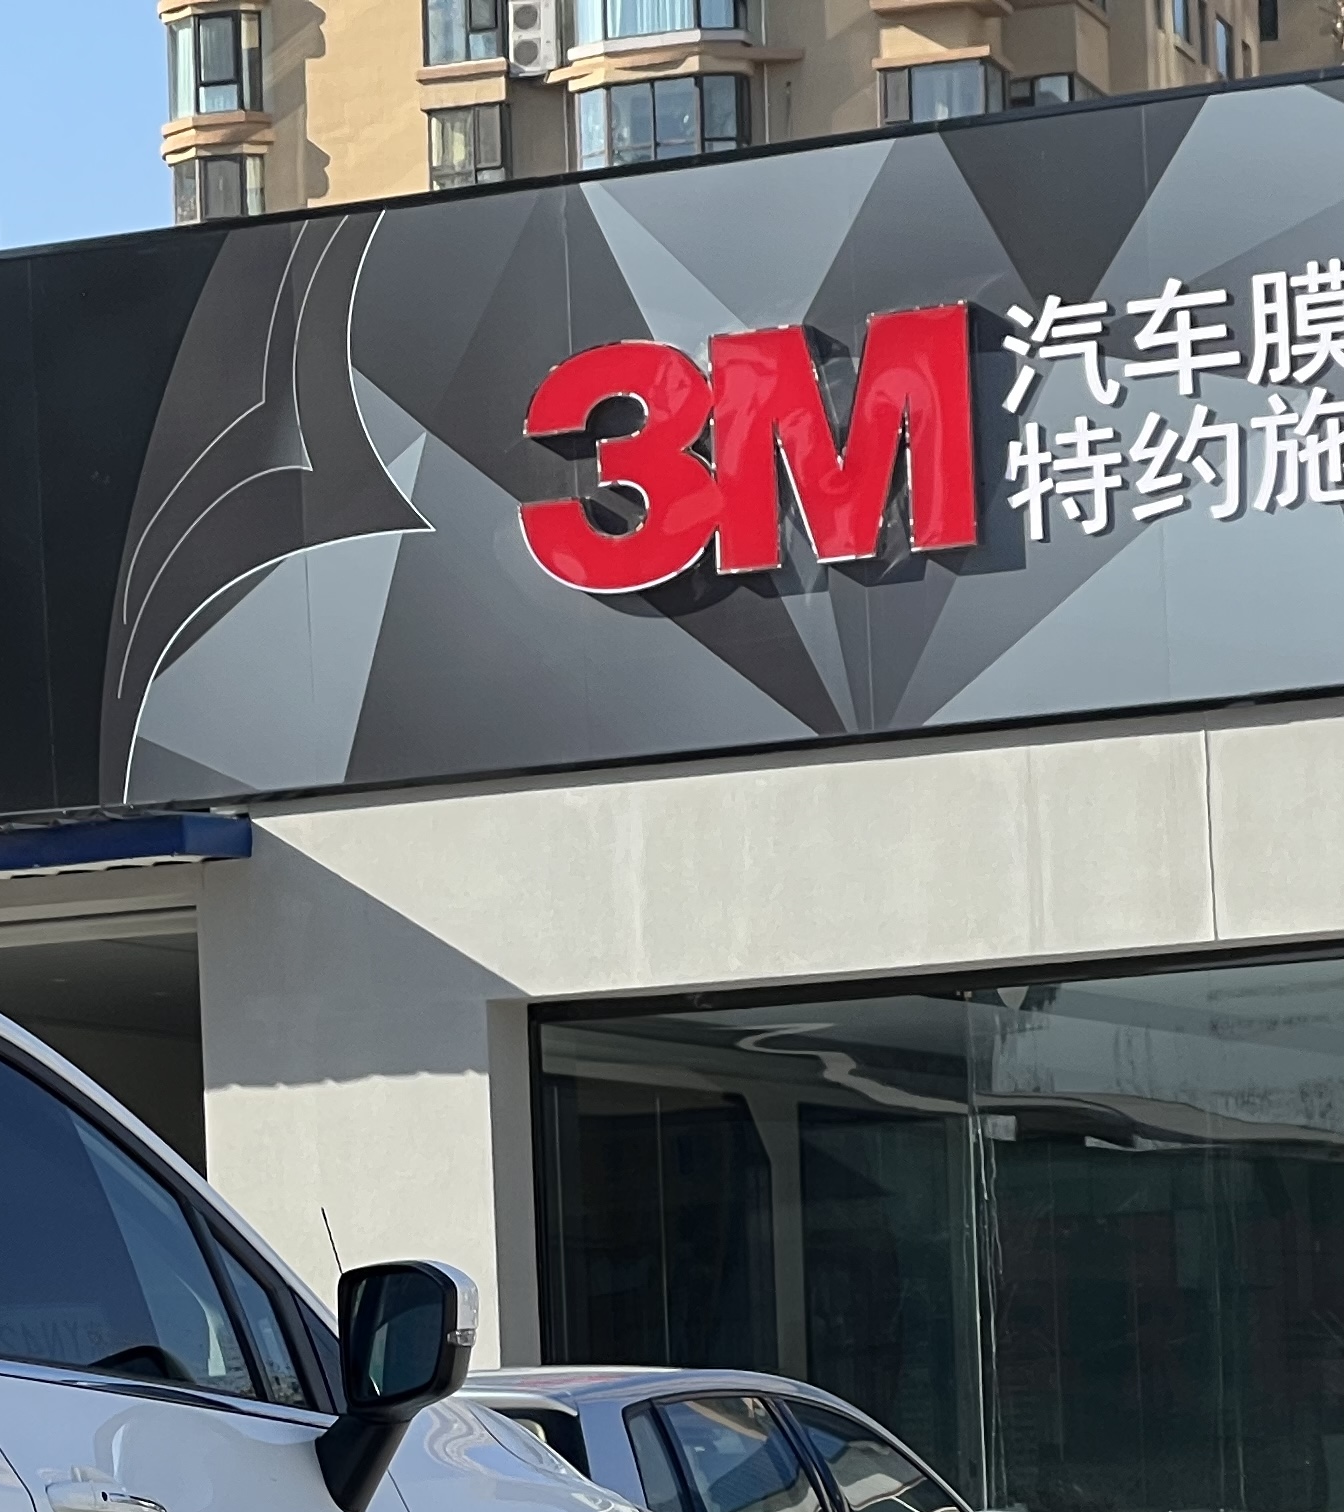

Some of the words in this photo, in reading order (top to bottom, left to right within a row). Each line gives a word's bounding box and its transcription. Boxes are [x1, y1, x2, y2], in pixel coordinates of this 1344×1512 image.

[1001, 257, 1344, 414] 汽车膜
[518, 299, 978, 594] 3M
[1004, 386, 1344, 541] 特约施
